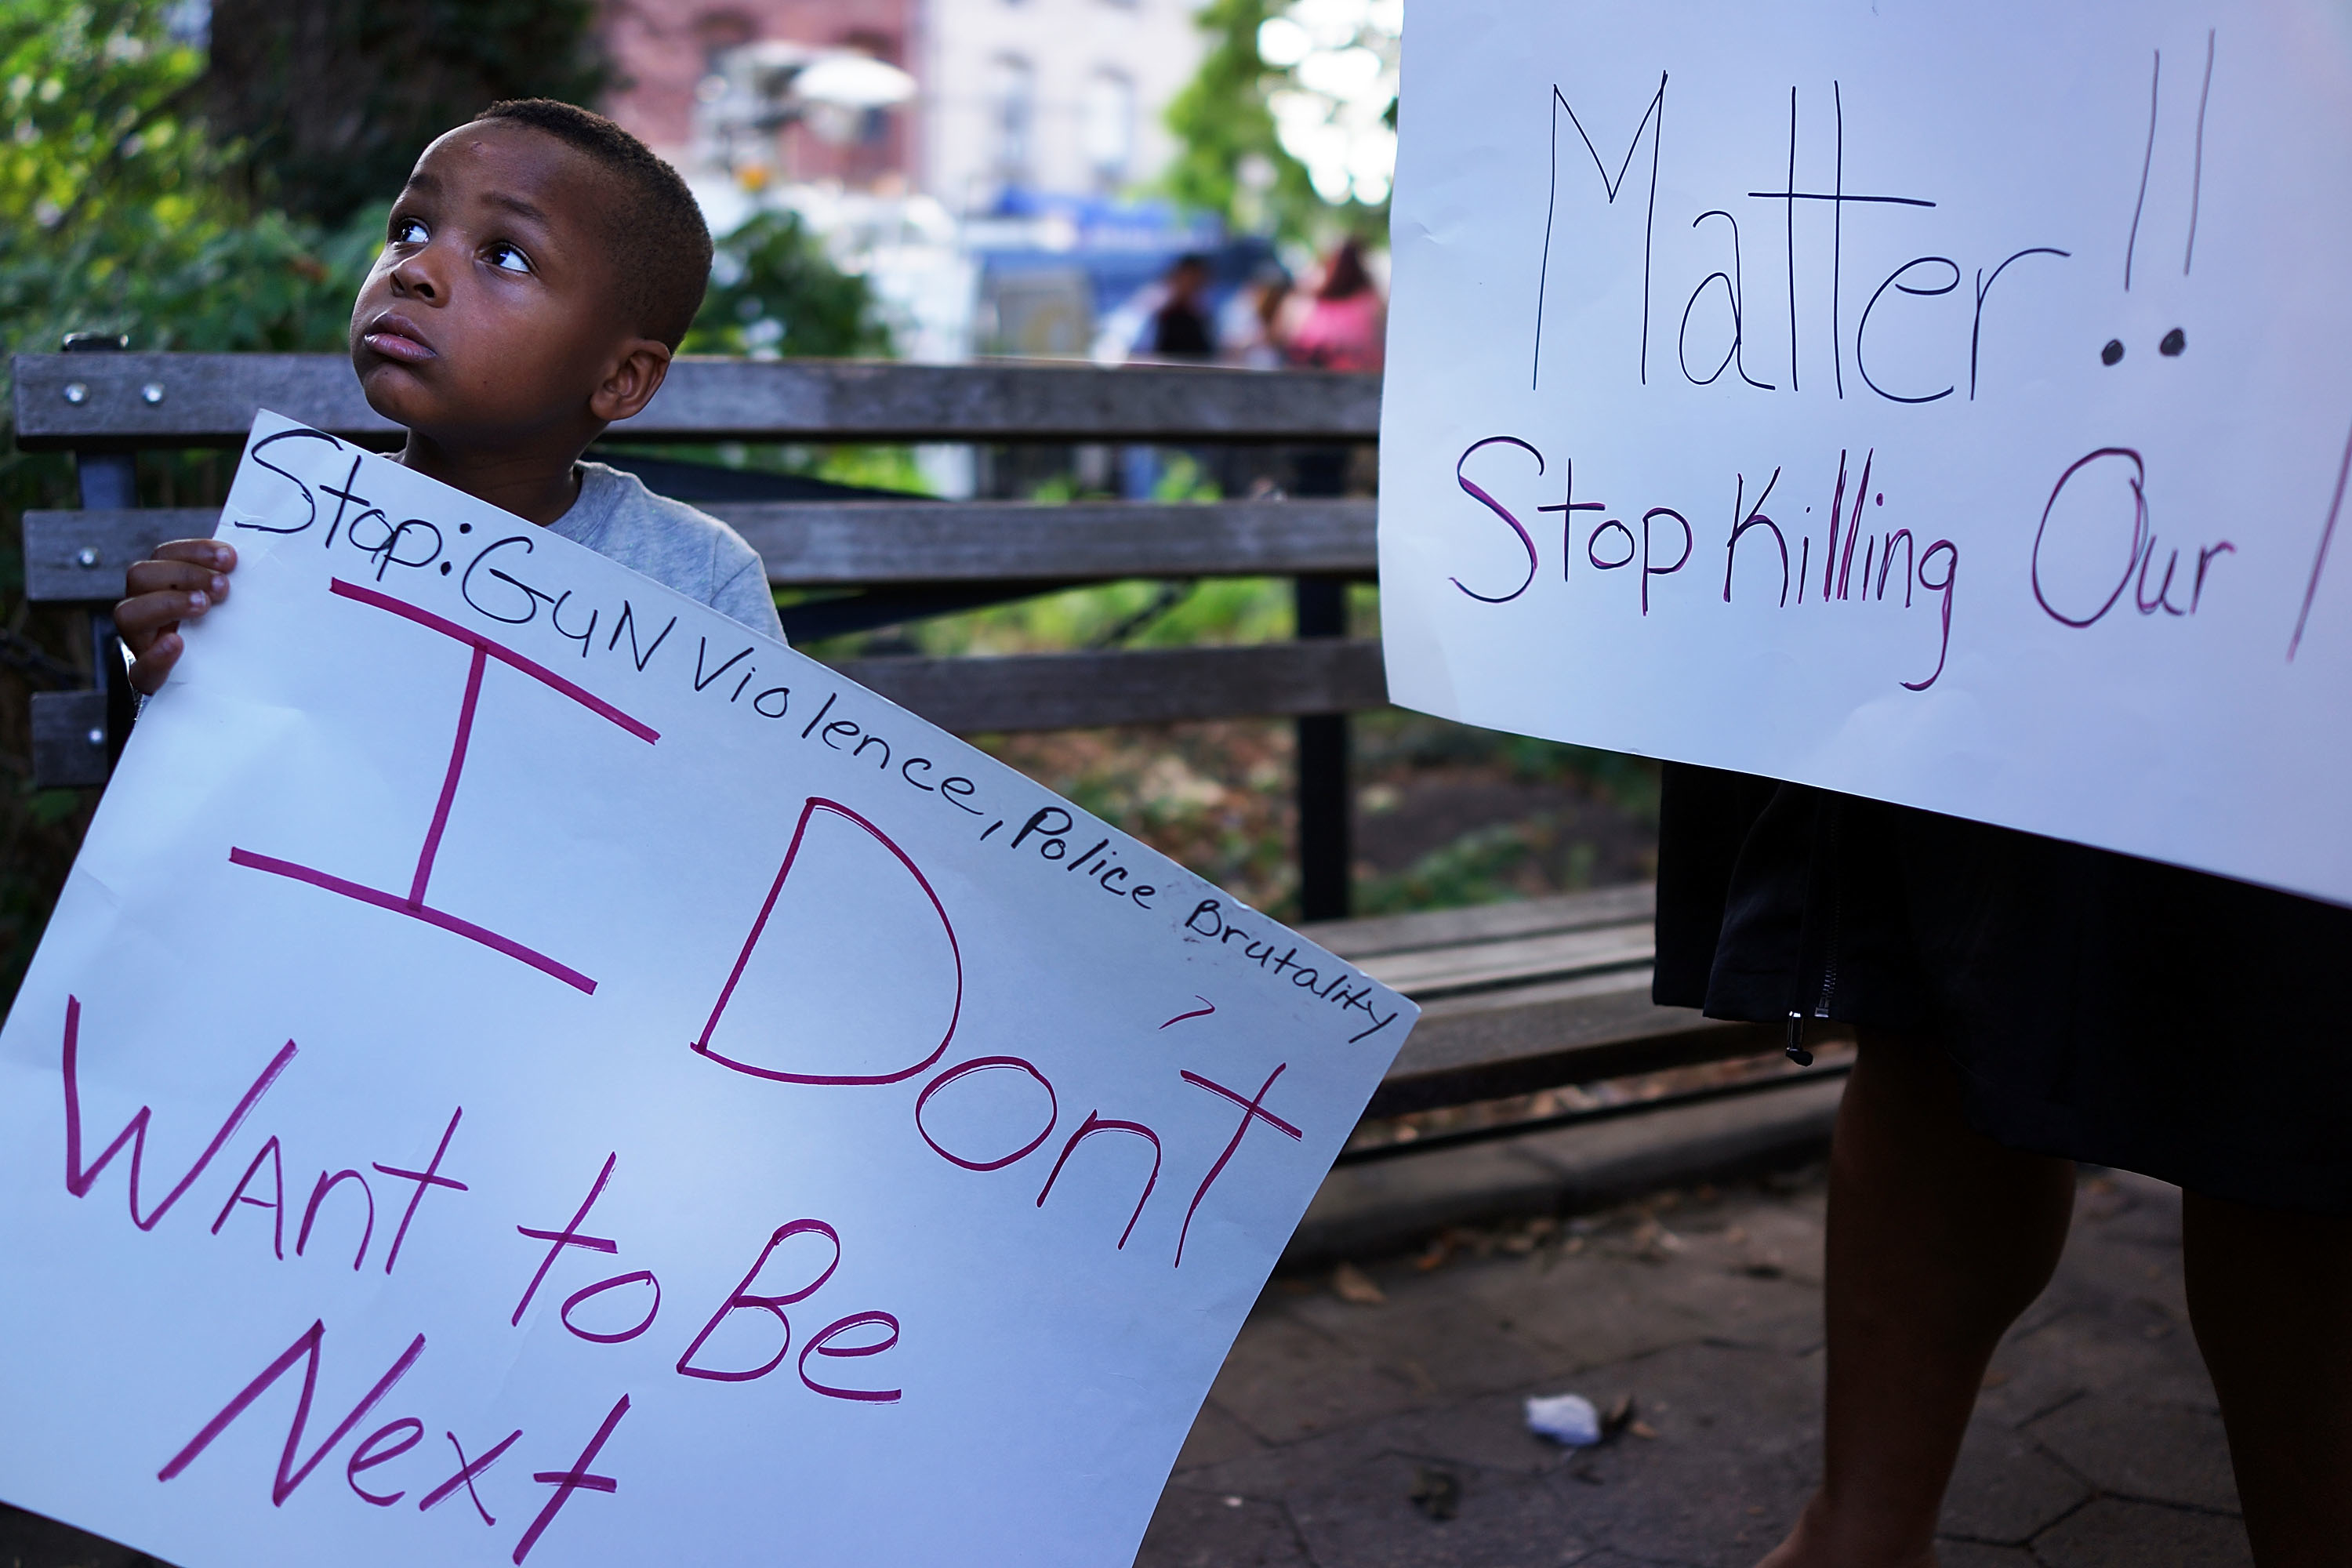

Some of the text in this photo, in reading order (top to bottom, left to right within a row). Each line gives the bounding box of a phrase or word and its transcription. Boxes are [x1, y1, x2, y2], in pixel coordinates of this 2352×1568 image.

[1448, 435, 1693, 616] Stop
[1723, 448, 1958, 691] Killing
[2032, 447, 2237, 629] Our
[229, 577, 662, 996] I
[695, 636, 1004, 841] Violence,
[1011, 806, 1156, 909] Police
[1185, 899, 1398, 1044] Brutality
[510, 1152, 662, 1345] to
[676, 1218, 902, 1404] Be
[158, 1319, 632, 1566] Next
